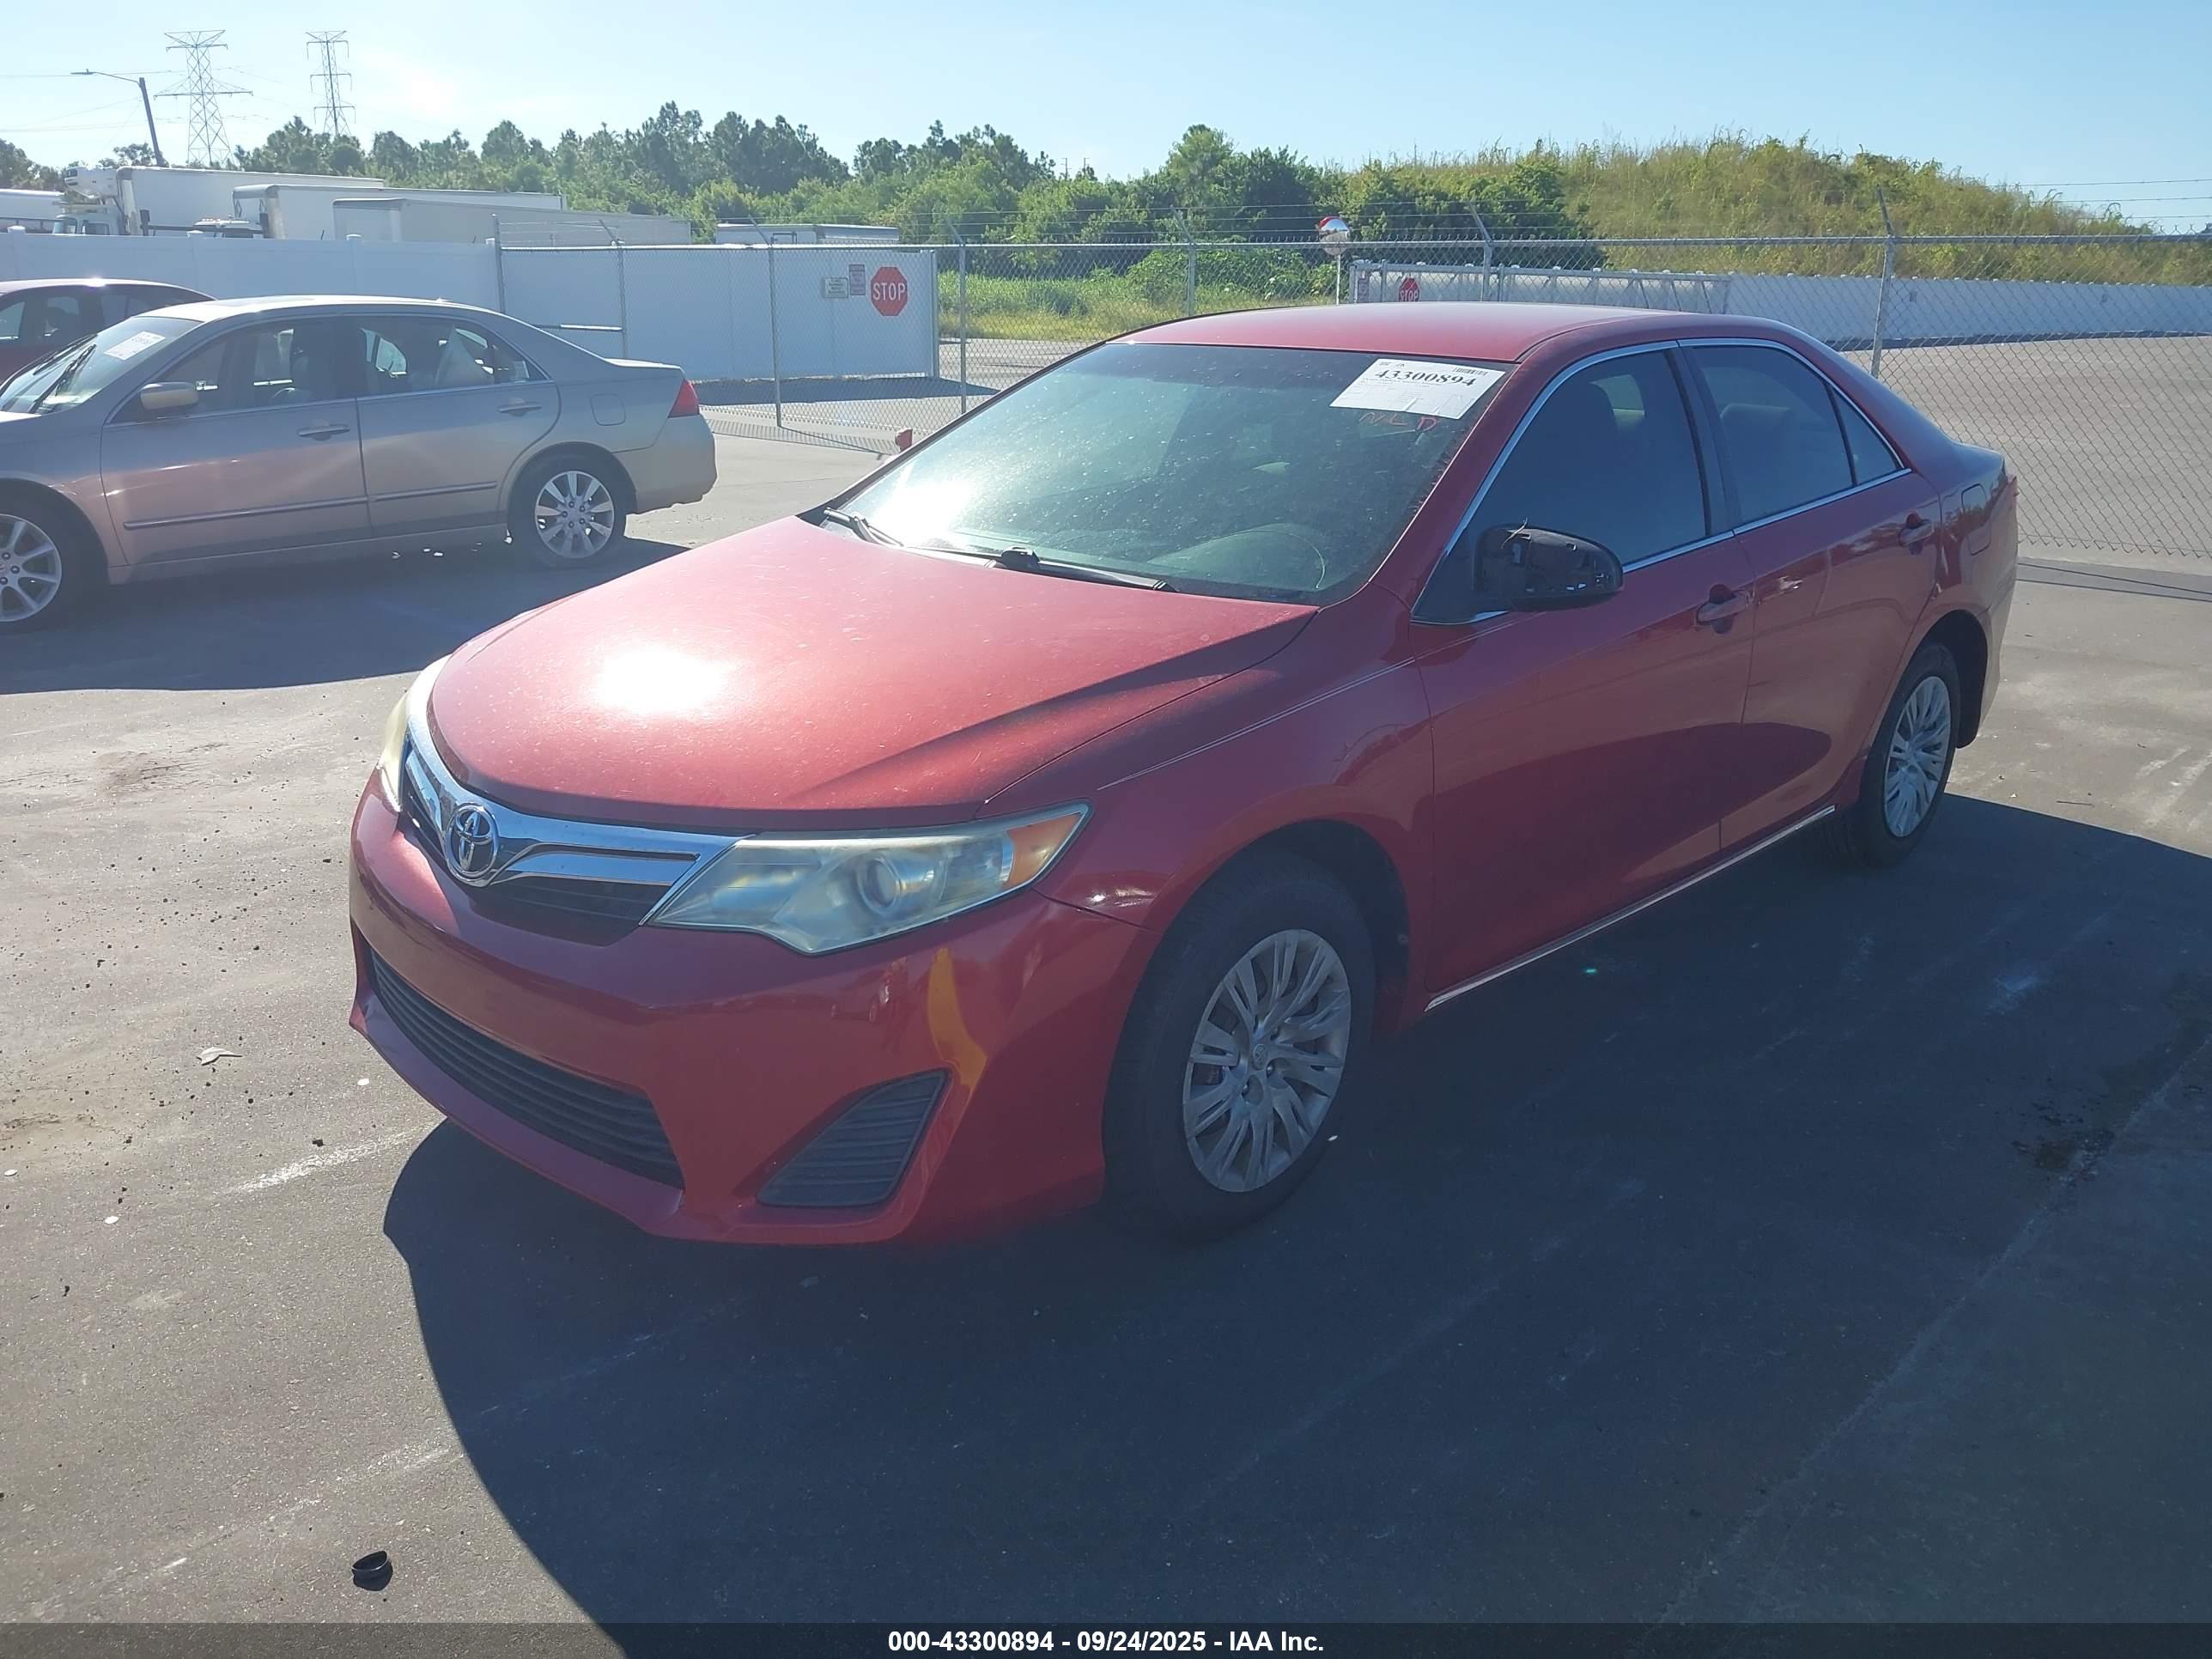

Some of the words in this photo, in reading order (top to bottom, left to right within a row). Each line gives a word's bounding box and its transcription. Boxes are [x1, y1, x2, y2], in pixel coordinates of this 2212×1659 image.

[872, 282, 906, 301] STOP
[1400, 290, 1419, 302] STOP
[1374, 369, 1477, 386] 43300894
